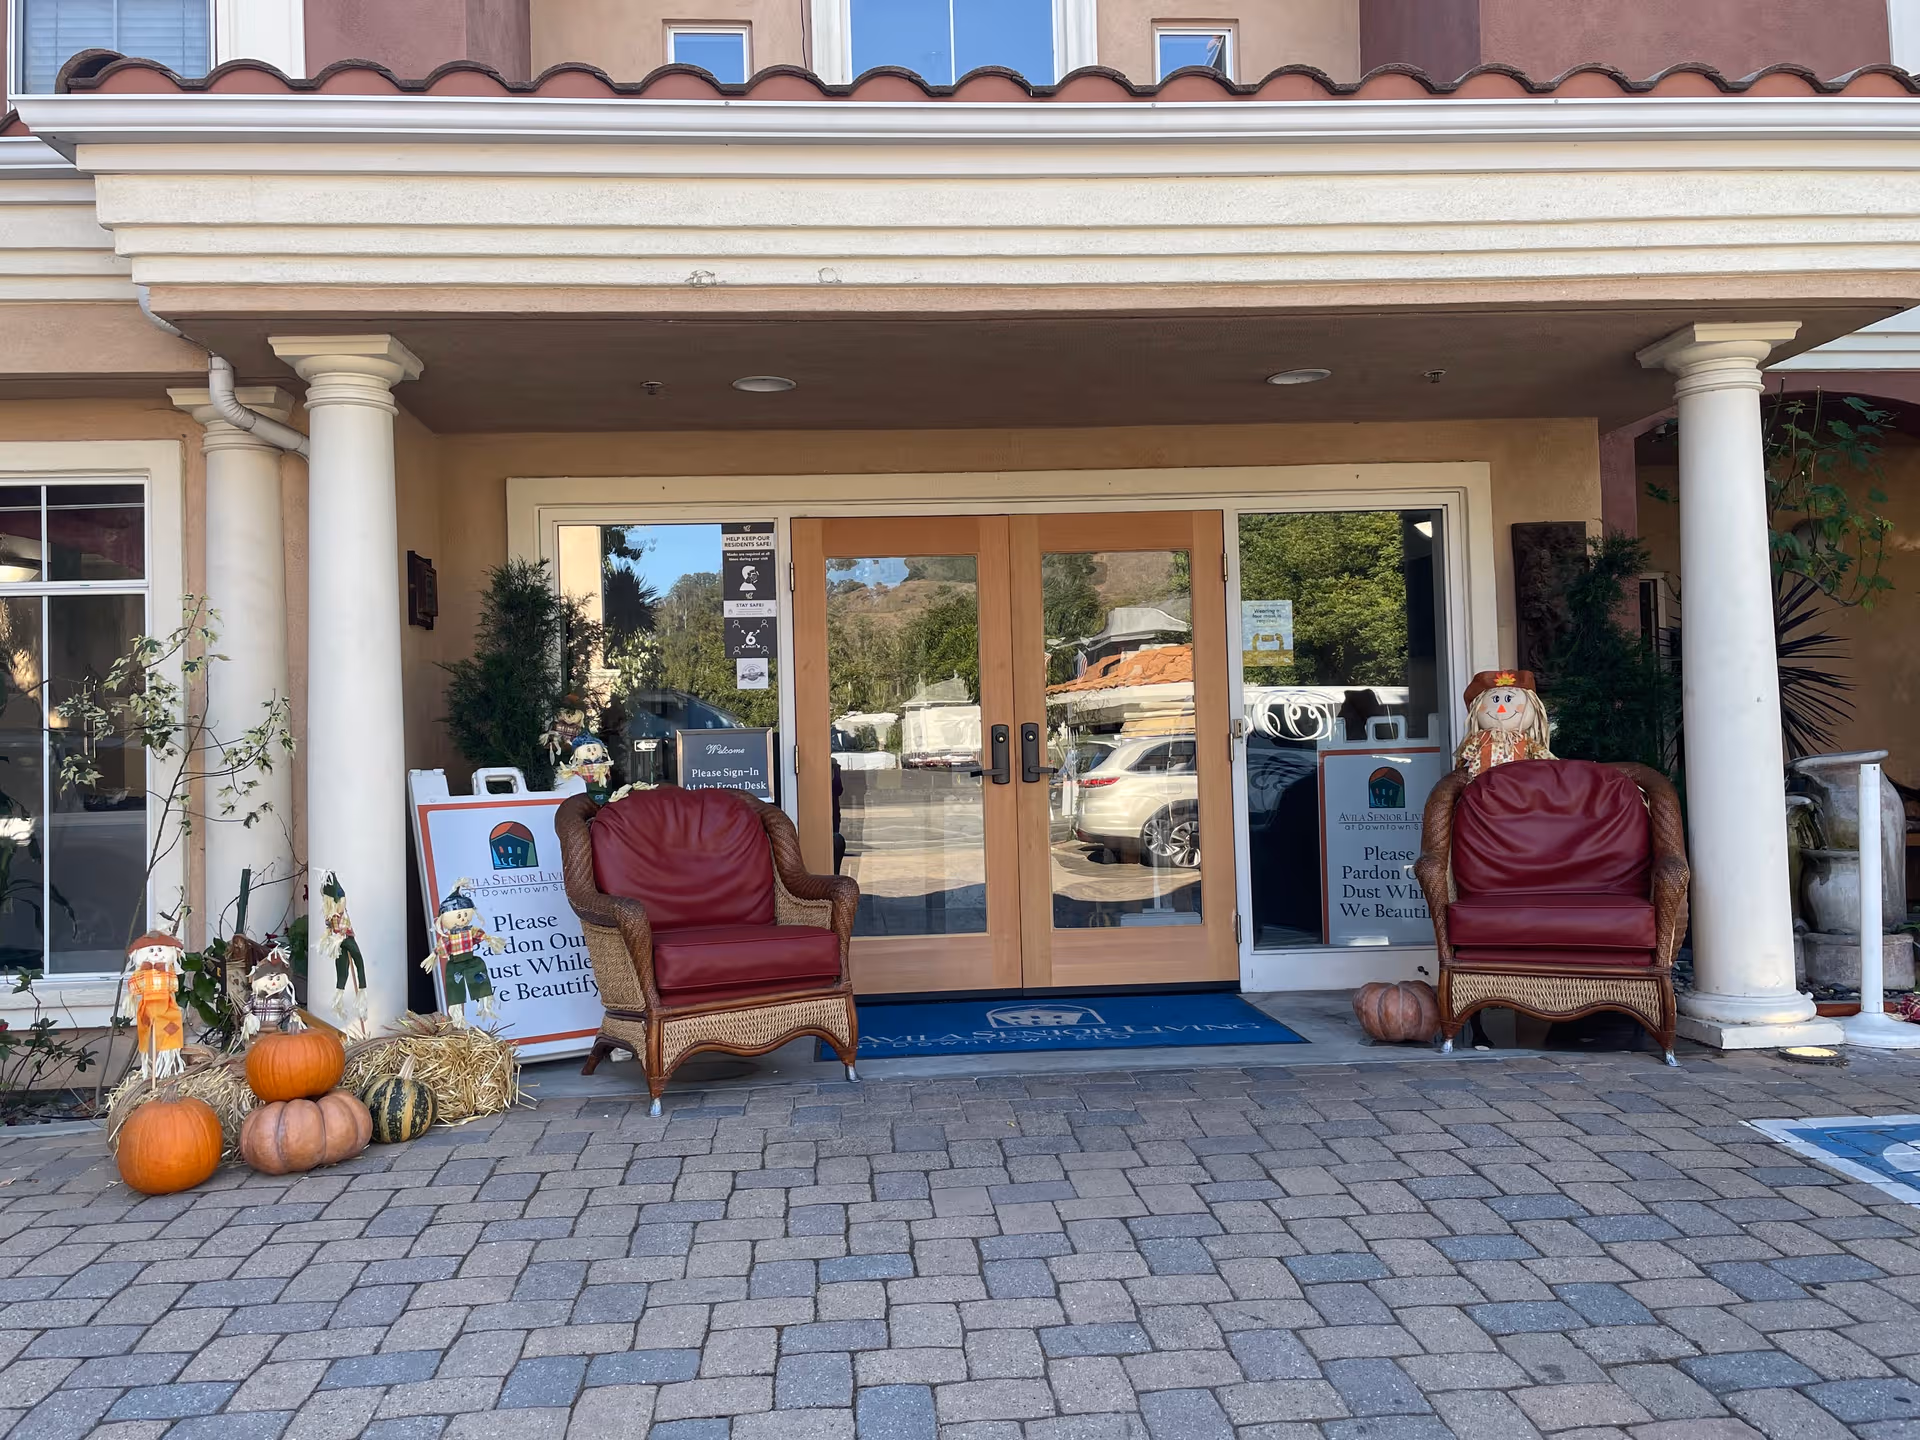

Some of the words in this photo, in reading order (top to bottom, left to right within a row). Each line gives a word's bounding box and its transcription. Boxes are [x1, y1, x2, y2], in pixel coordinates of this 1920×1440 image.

[746, 632, 756, 645] 6
[705, 744, 746, 755] Welcome
[691, 768, 722, 778] Please
[723, 766, 760, 778] Sign-In
[744, 780, 767, 790] Desk
[1364, 846, 1415, 861] Please
[1342, 864, 1401, 880] Pardon
[482, 885, 549, 898] Downtown
[1342, 884, 1382, 898] Dust
[1386, 884, 1426, 900] Whi
[1340, 902, 1370, 917] We
[492, 913, 558, 932] Please
[473, 936, 544, 956] adon
[488, 962, 522, 980] ust
[526, 952, 592, 974] While
[515, 974, 599, 1001] Beautify
